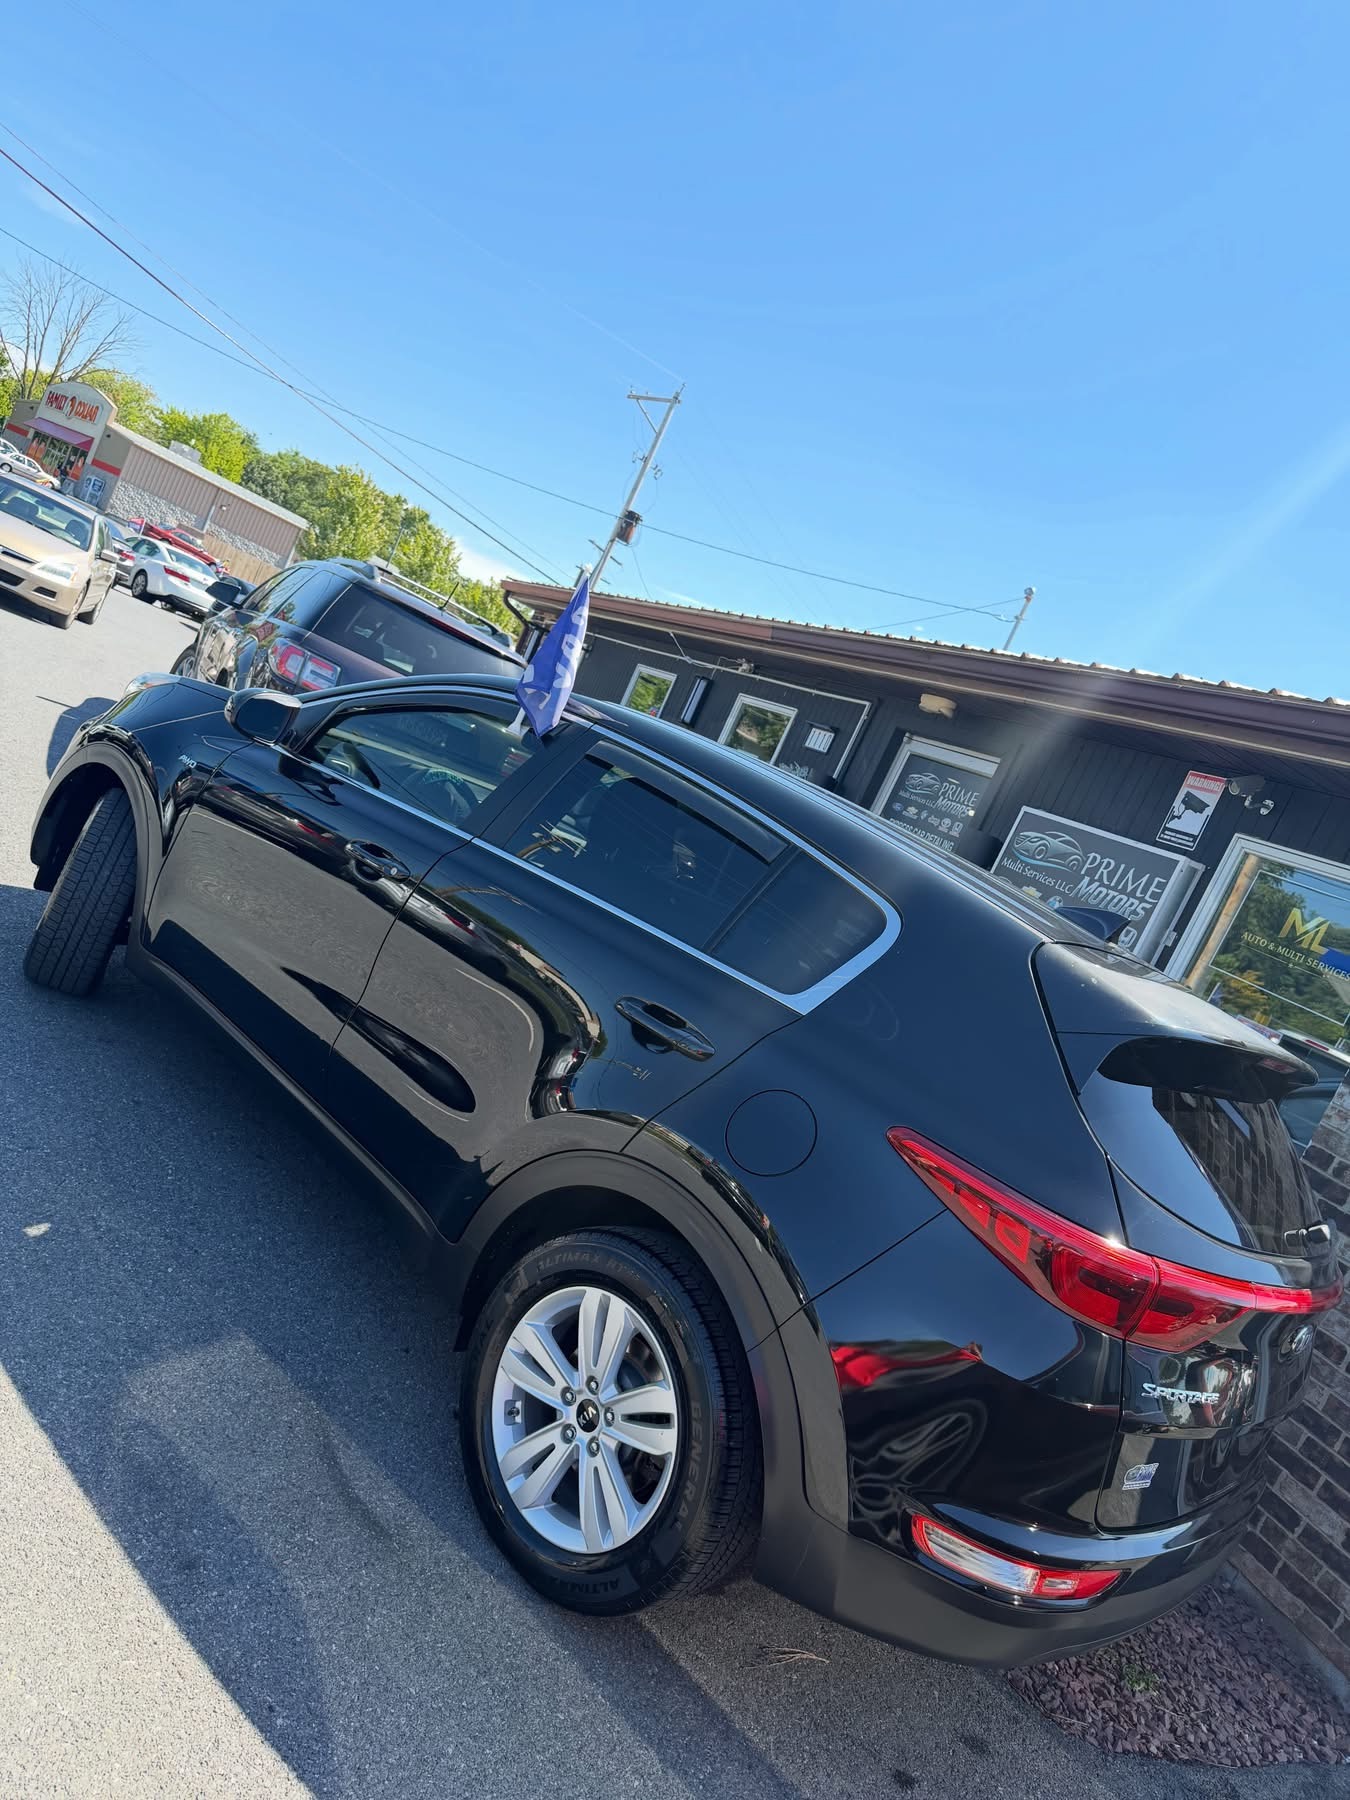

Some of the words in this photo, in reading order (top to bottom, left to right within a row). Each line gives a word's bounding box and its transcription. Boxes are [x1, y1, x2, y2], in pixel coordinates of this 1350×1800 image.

[178, 754, 197, 769] AWD
[933, 796, 972, 818] MOTORS
[939, 782, 980, 807] PRIME
[1001, 857, 1023, 874] Multi
[1022, 866, 1055, 889] Services
[1055, 880, 1074, 895] LLC
[1080, 852, 1168, 903] PRIME
[1070, 876, 1153, 921] MOTORS
[1278, 907, 1331, 955] ML
[1241, 931, 1268, 947] AUTO
[1267, 941, 1276, 951] &
[1276, 946, 1306, 964] MULTI
[1305, 957, 1350, 981] SERVICES
[1141, 1383, 1220, 1404] SPORTAGE
[578, 1406, 597, 1427] KIA
